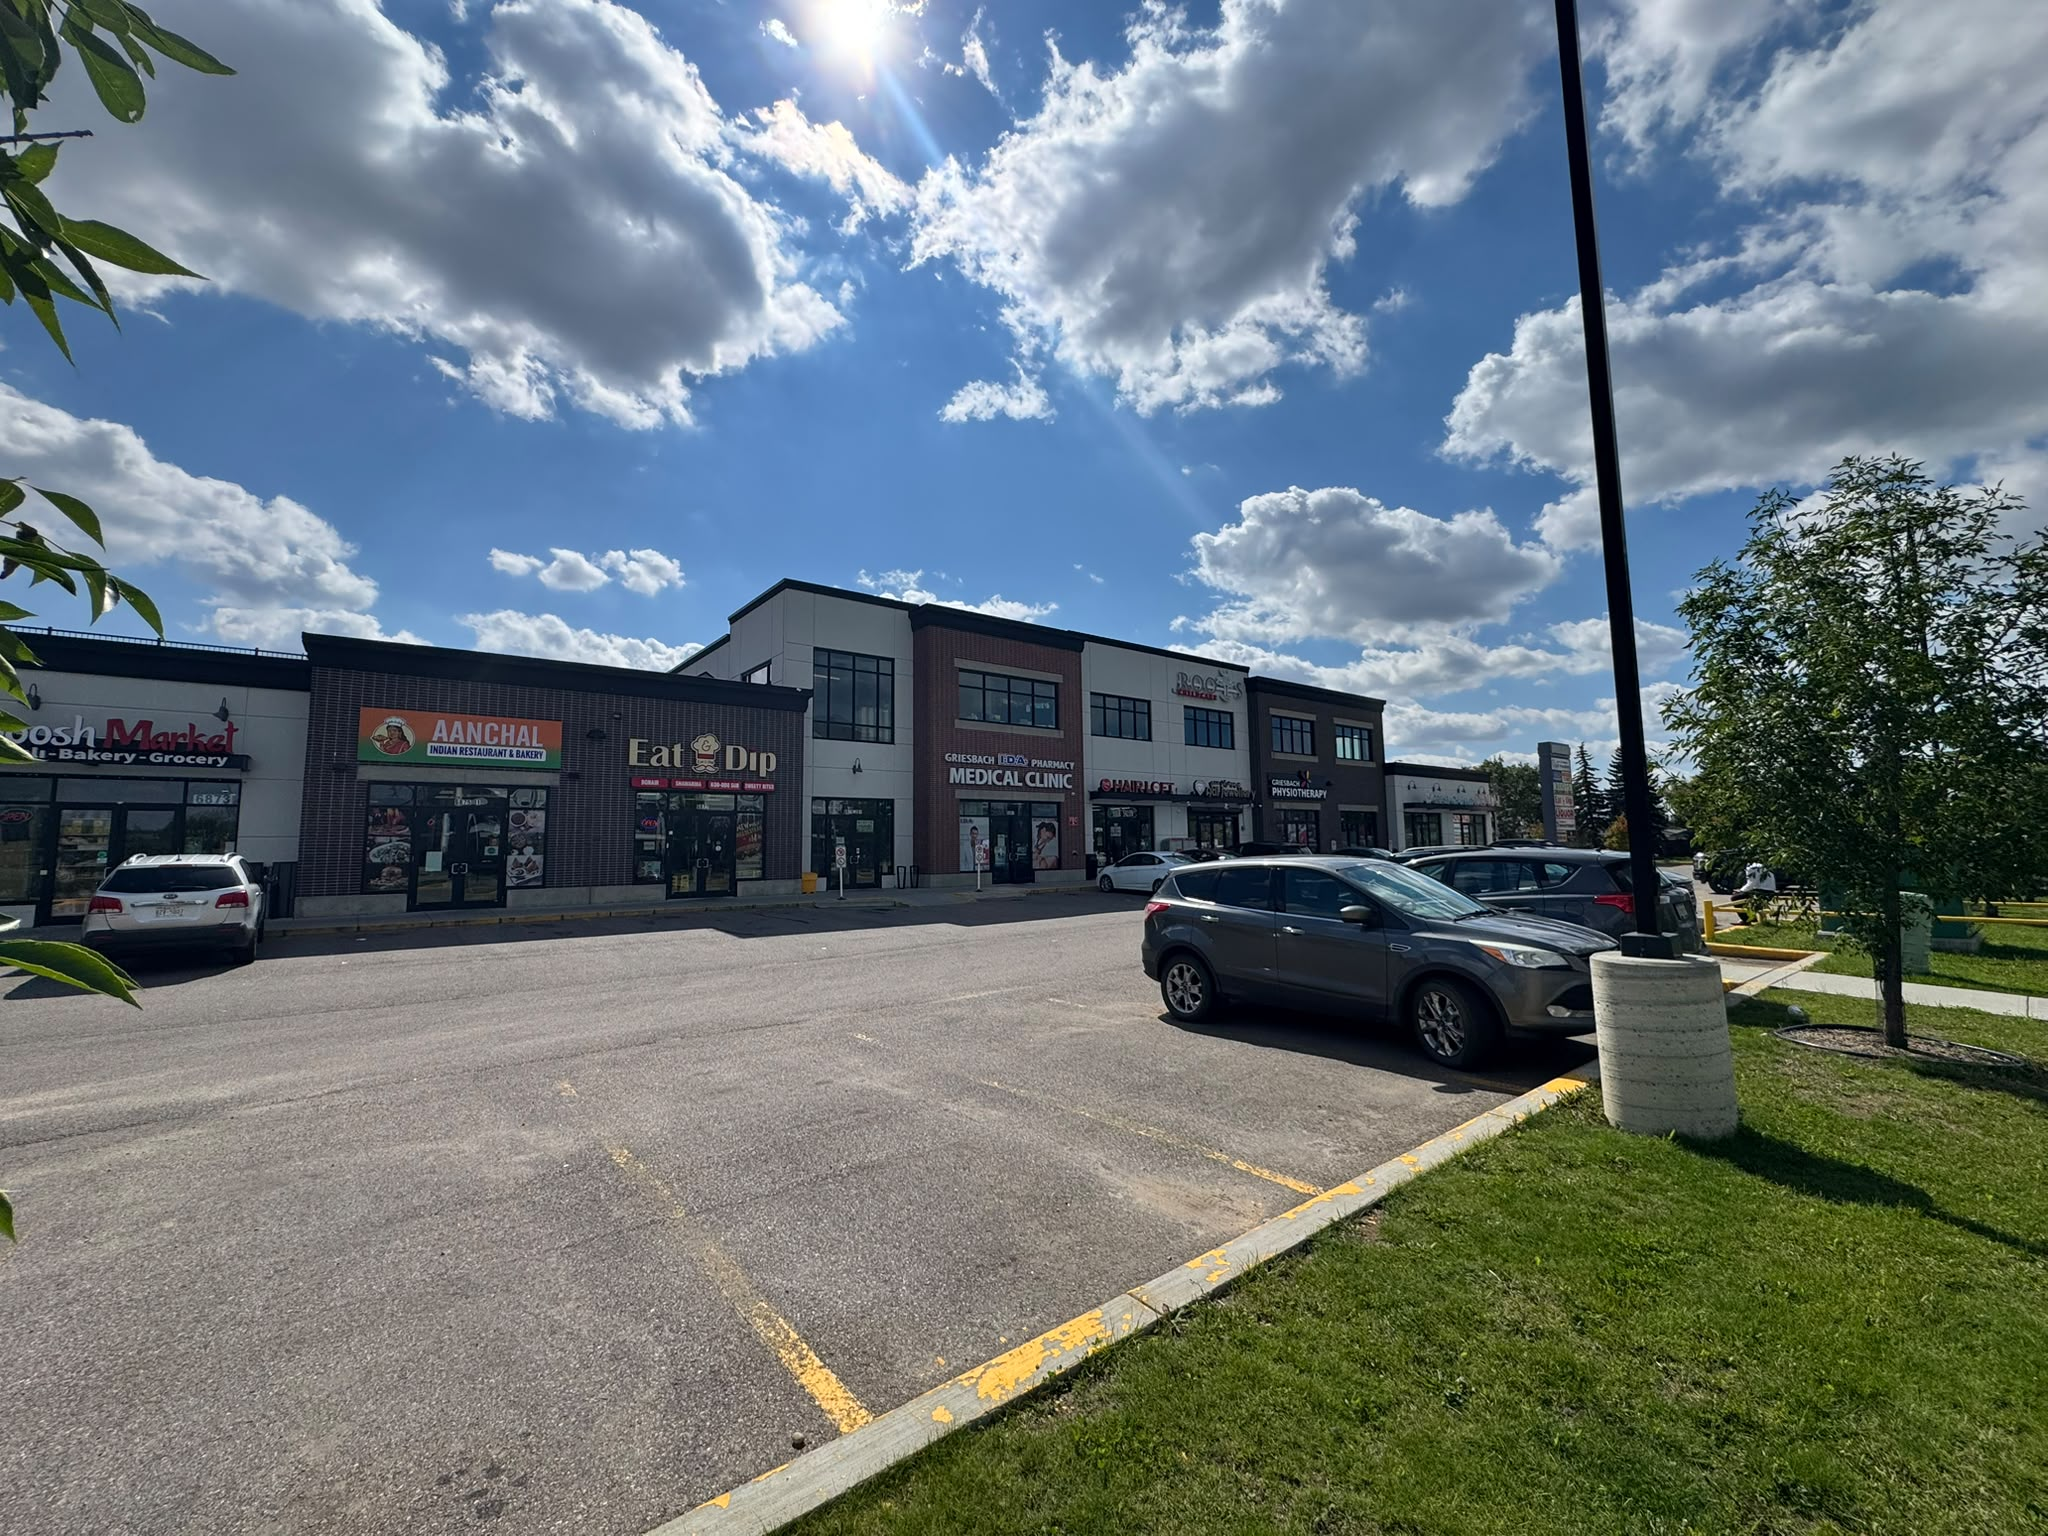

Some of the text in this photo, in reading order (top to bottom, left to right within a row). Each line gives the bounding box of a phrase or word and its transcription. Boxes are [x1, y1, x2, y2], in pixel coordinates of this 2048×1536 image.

[0, 714, 240, 754] oosh Market
[432, 719, 544, 748] AANCHAL
[58, 748, 138, 764] Bakery
[149, 752, 229, 768] Grocery
[430, 745, 544, 760] INDIAN RESTAURANT & BAKERY
[628, 738, 685, 768] Eat
[725, 744, 777, 778] Dip
[944, 752, 995, 765] GRIESBACH
[1031, 758, 1075, 770] PHARMACY
[949, 767, 1073, 789] MEDICAL CLINIC
[1271, 778, 1301, 787] GRIESBACH
[1272, 787, 1328, 799] PHYSIOTHERAPY
